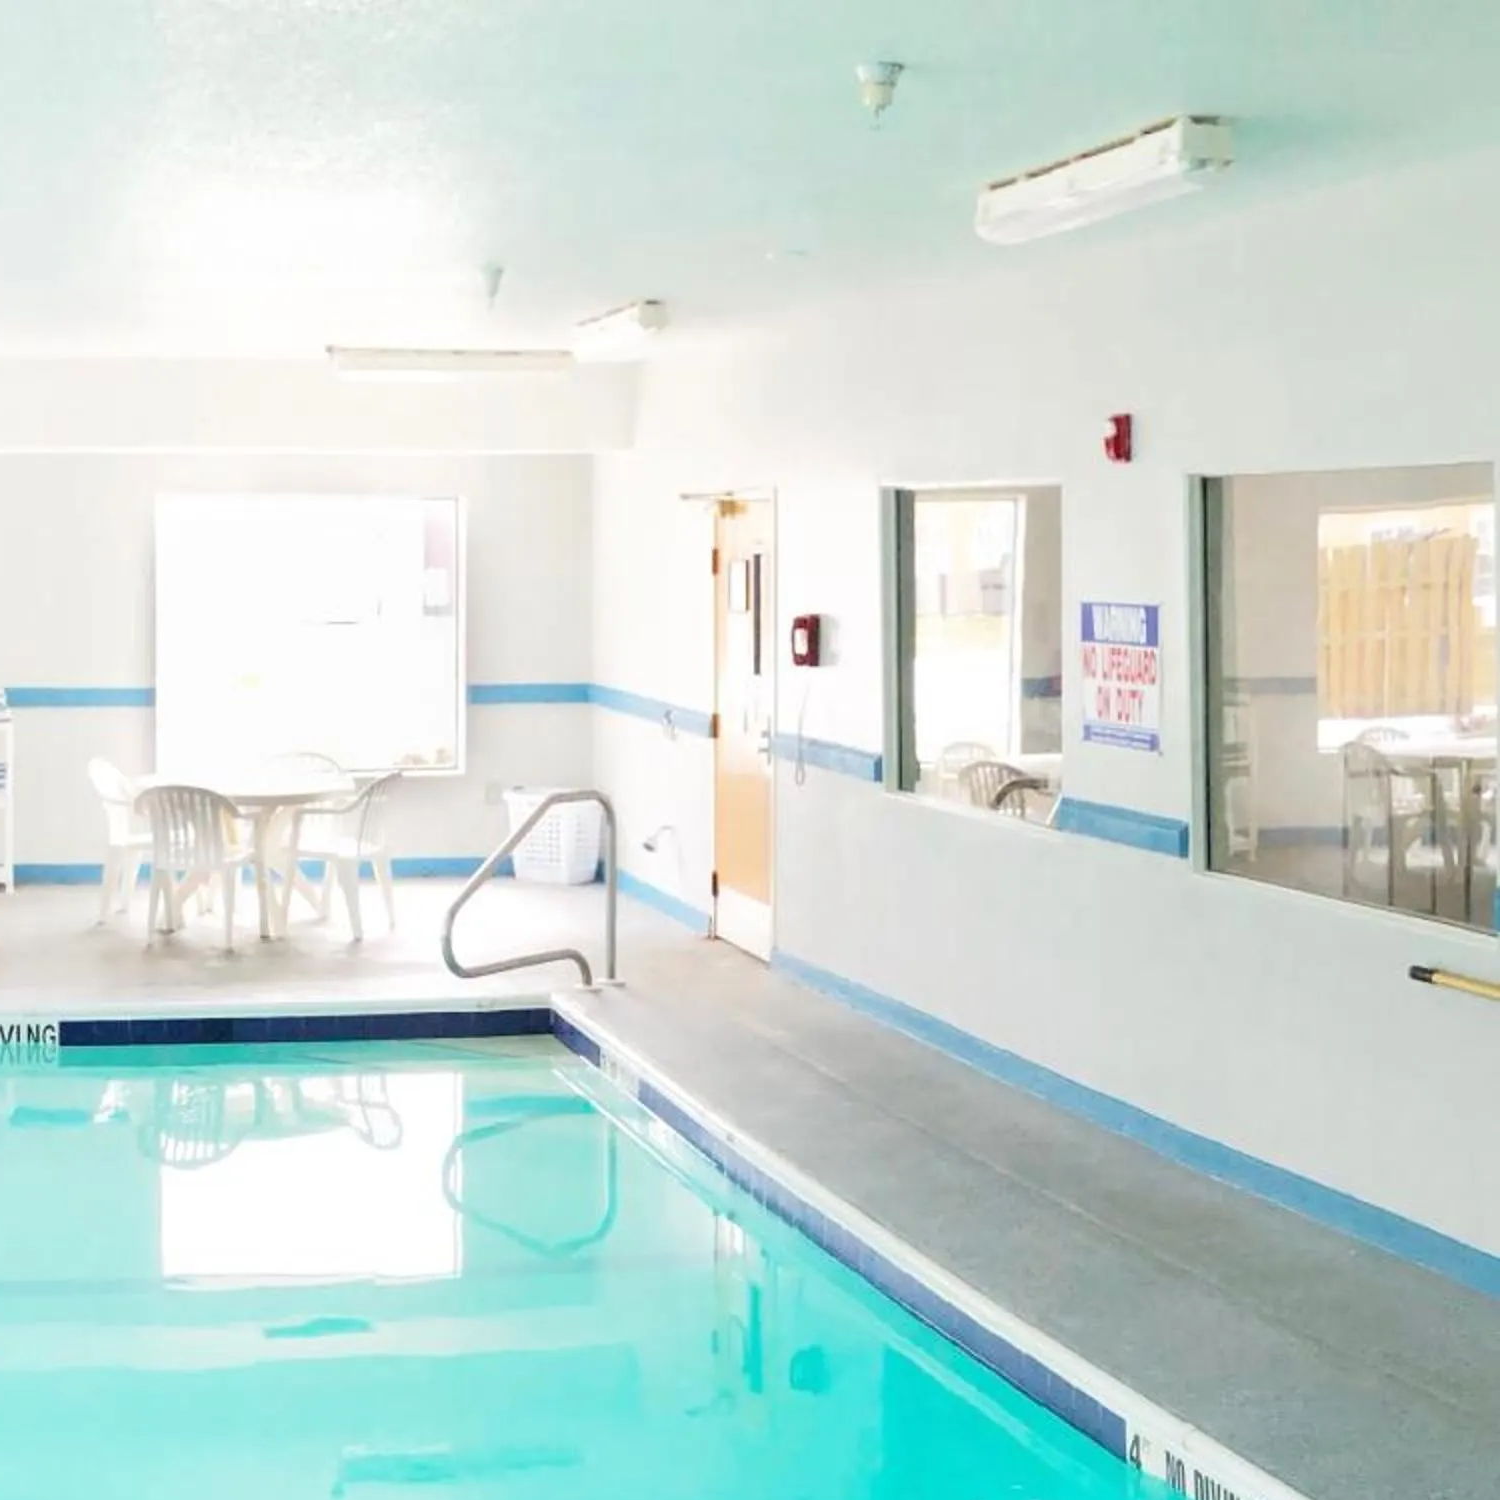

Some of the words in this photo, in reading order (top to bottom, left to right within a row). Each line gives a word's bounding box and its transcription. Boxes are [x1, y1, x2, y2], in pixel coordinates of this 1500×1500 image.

[1092, 606, 1147, 643] WARNING
[1083, 647, 1097, 680] NO
[1102, 647, 1157, 685] LIFEGUARD
[1097, 686, 1111, 719] ON
[1116, 688, 1143, 723] DUTY
[1166, 1450, 1186, 1496] NO
